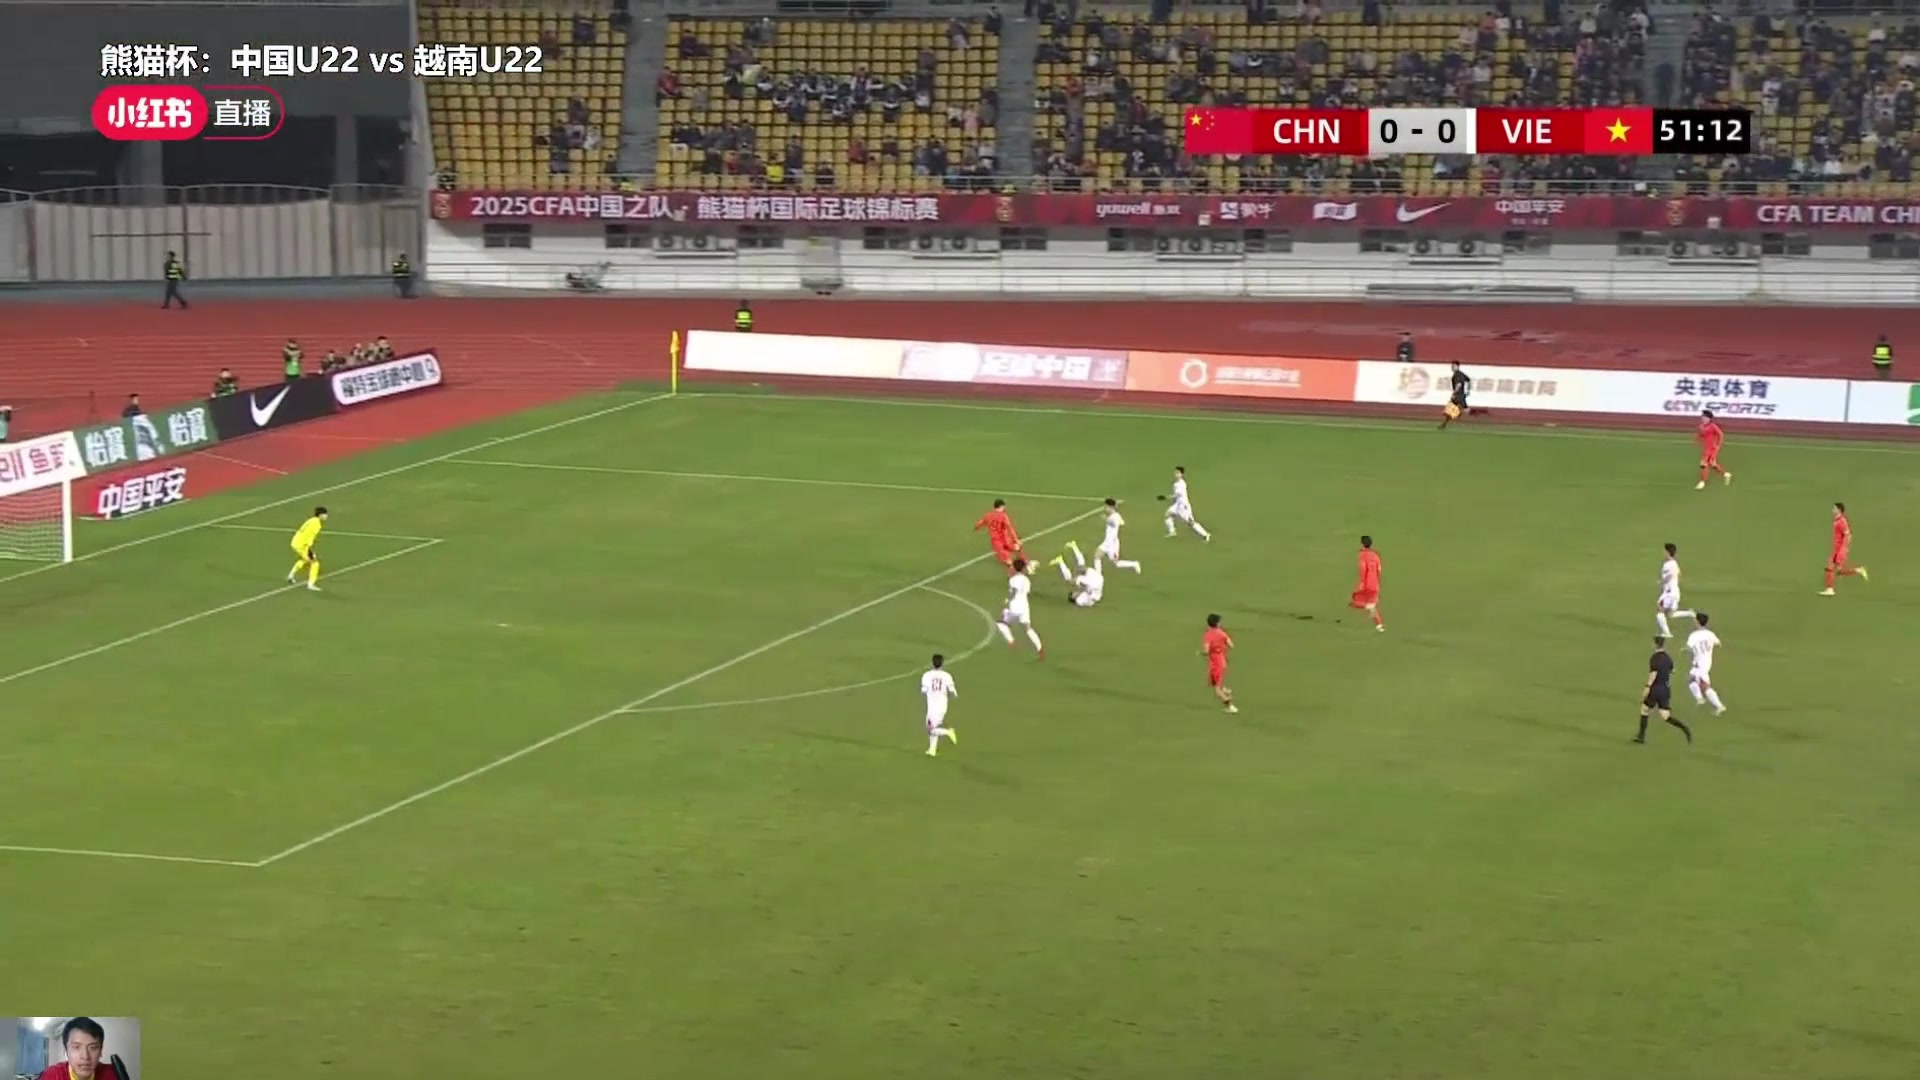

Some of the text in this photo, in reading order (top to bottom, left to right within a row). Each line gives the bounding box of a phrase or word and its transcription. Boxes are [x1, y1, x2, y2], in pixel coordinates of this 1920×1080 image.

[1495, 200, 1566, 214] 中国平安
[1757, 205, 1802, 222] CFA
[1807, 205, 1875, 223] TEAM
[1674, 377, 1770, 398] 央视体育
[1663, 400, 1778, 415] CCTV SPORTS
[97, 467, 187, 520] 中国平安
